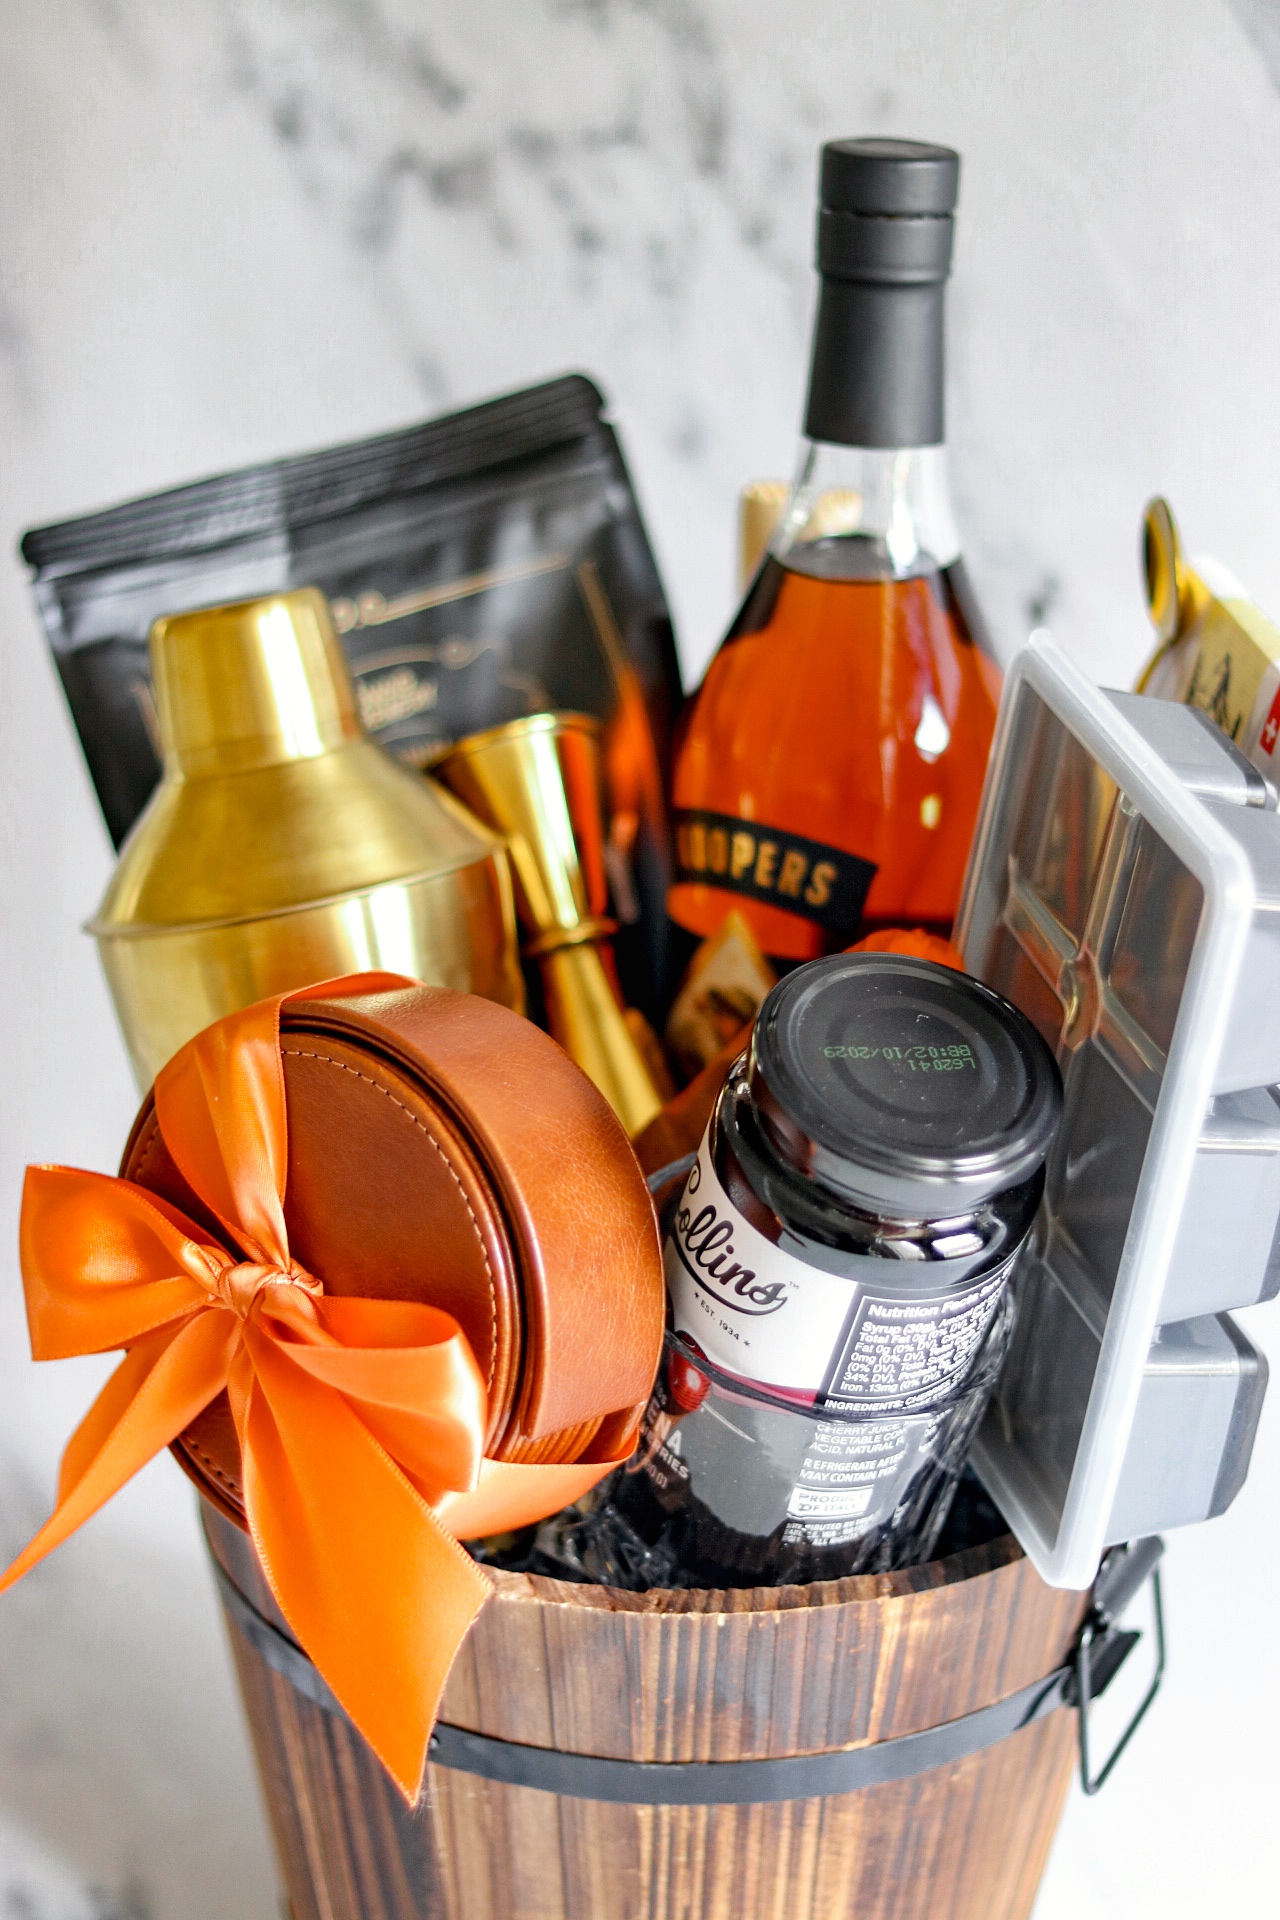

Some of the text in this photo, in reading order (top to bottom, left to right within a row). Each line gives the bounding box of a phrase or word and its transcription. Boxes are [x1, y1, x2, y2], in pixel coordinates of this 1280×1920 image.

[823, 1044, 972, 1061] BB:02/10/2029
[907, 1057, 976, 1072] L62041
[867, 1303, 940, 1319] Nutrition
[940, 1291, 981, 1315] Facts
[700, 1300, 741, 1341] EST. 1934
[861, 1320, 901, 1336] Syrup
[859, 1331, 890, 1344] Total
[890, 1334, 911, 1344] Fat
[854, 1341, 874, 1353] Fat
[875, 1343, 892, 1357] 0g
[892, 1343, 915, 1356] (0%
[847, 1361, 870, 1373] (0%
[900, 1359, 926, 1373] Total
[850, 1351, 877, 1365] 0mg
[878, 1352, 901, 1367] (0%
[843, 1371, 869, 1383] 34%
[839, 1380, 864, 1393] Iron
[899, 1378, 921, 1392] (0%
[824, 1398, 905, 1413] INGREDIENTS:
[844, 1440, 895, 1455] NATURAL
[829, 1469, 877, 1483] CONTAIN
[823, 1502, 858, 1512] ITALY
